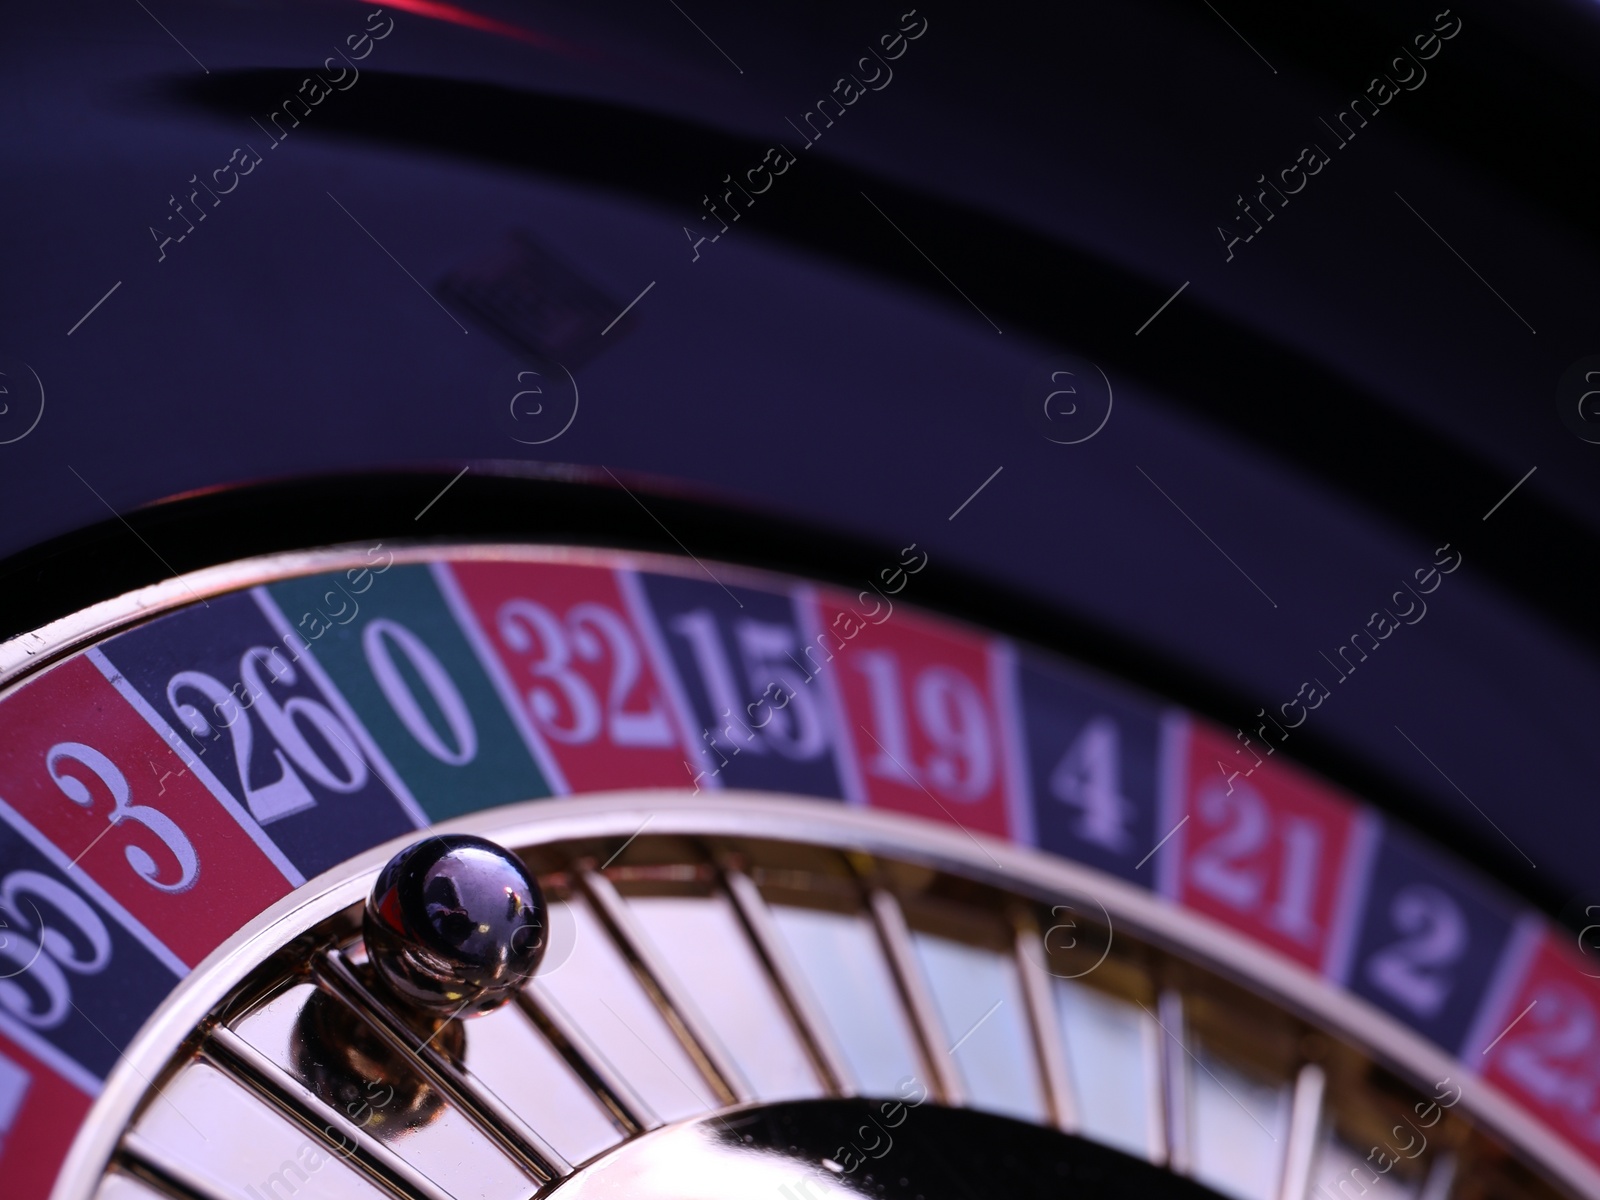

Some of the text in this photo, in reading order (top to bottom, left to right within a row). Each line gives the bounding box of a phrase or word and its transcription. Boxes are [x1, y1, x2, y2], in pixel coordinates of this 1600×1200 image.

[167, 646, 367, 825] 26
[362, 618, 479, 766] 0
[498, 600, 682, 747] 32
[673, 611, 830, 760] 15
[856, 649, 996, 803] 19
[46, 742, 200, 894] 3
[1050, 714, 1136, 853] 4
[1190, 778, 1324, 946] 21
[1367, 885, 1467, 1018] 2
[1502, 980, 1600, 1143] 2
